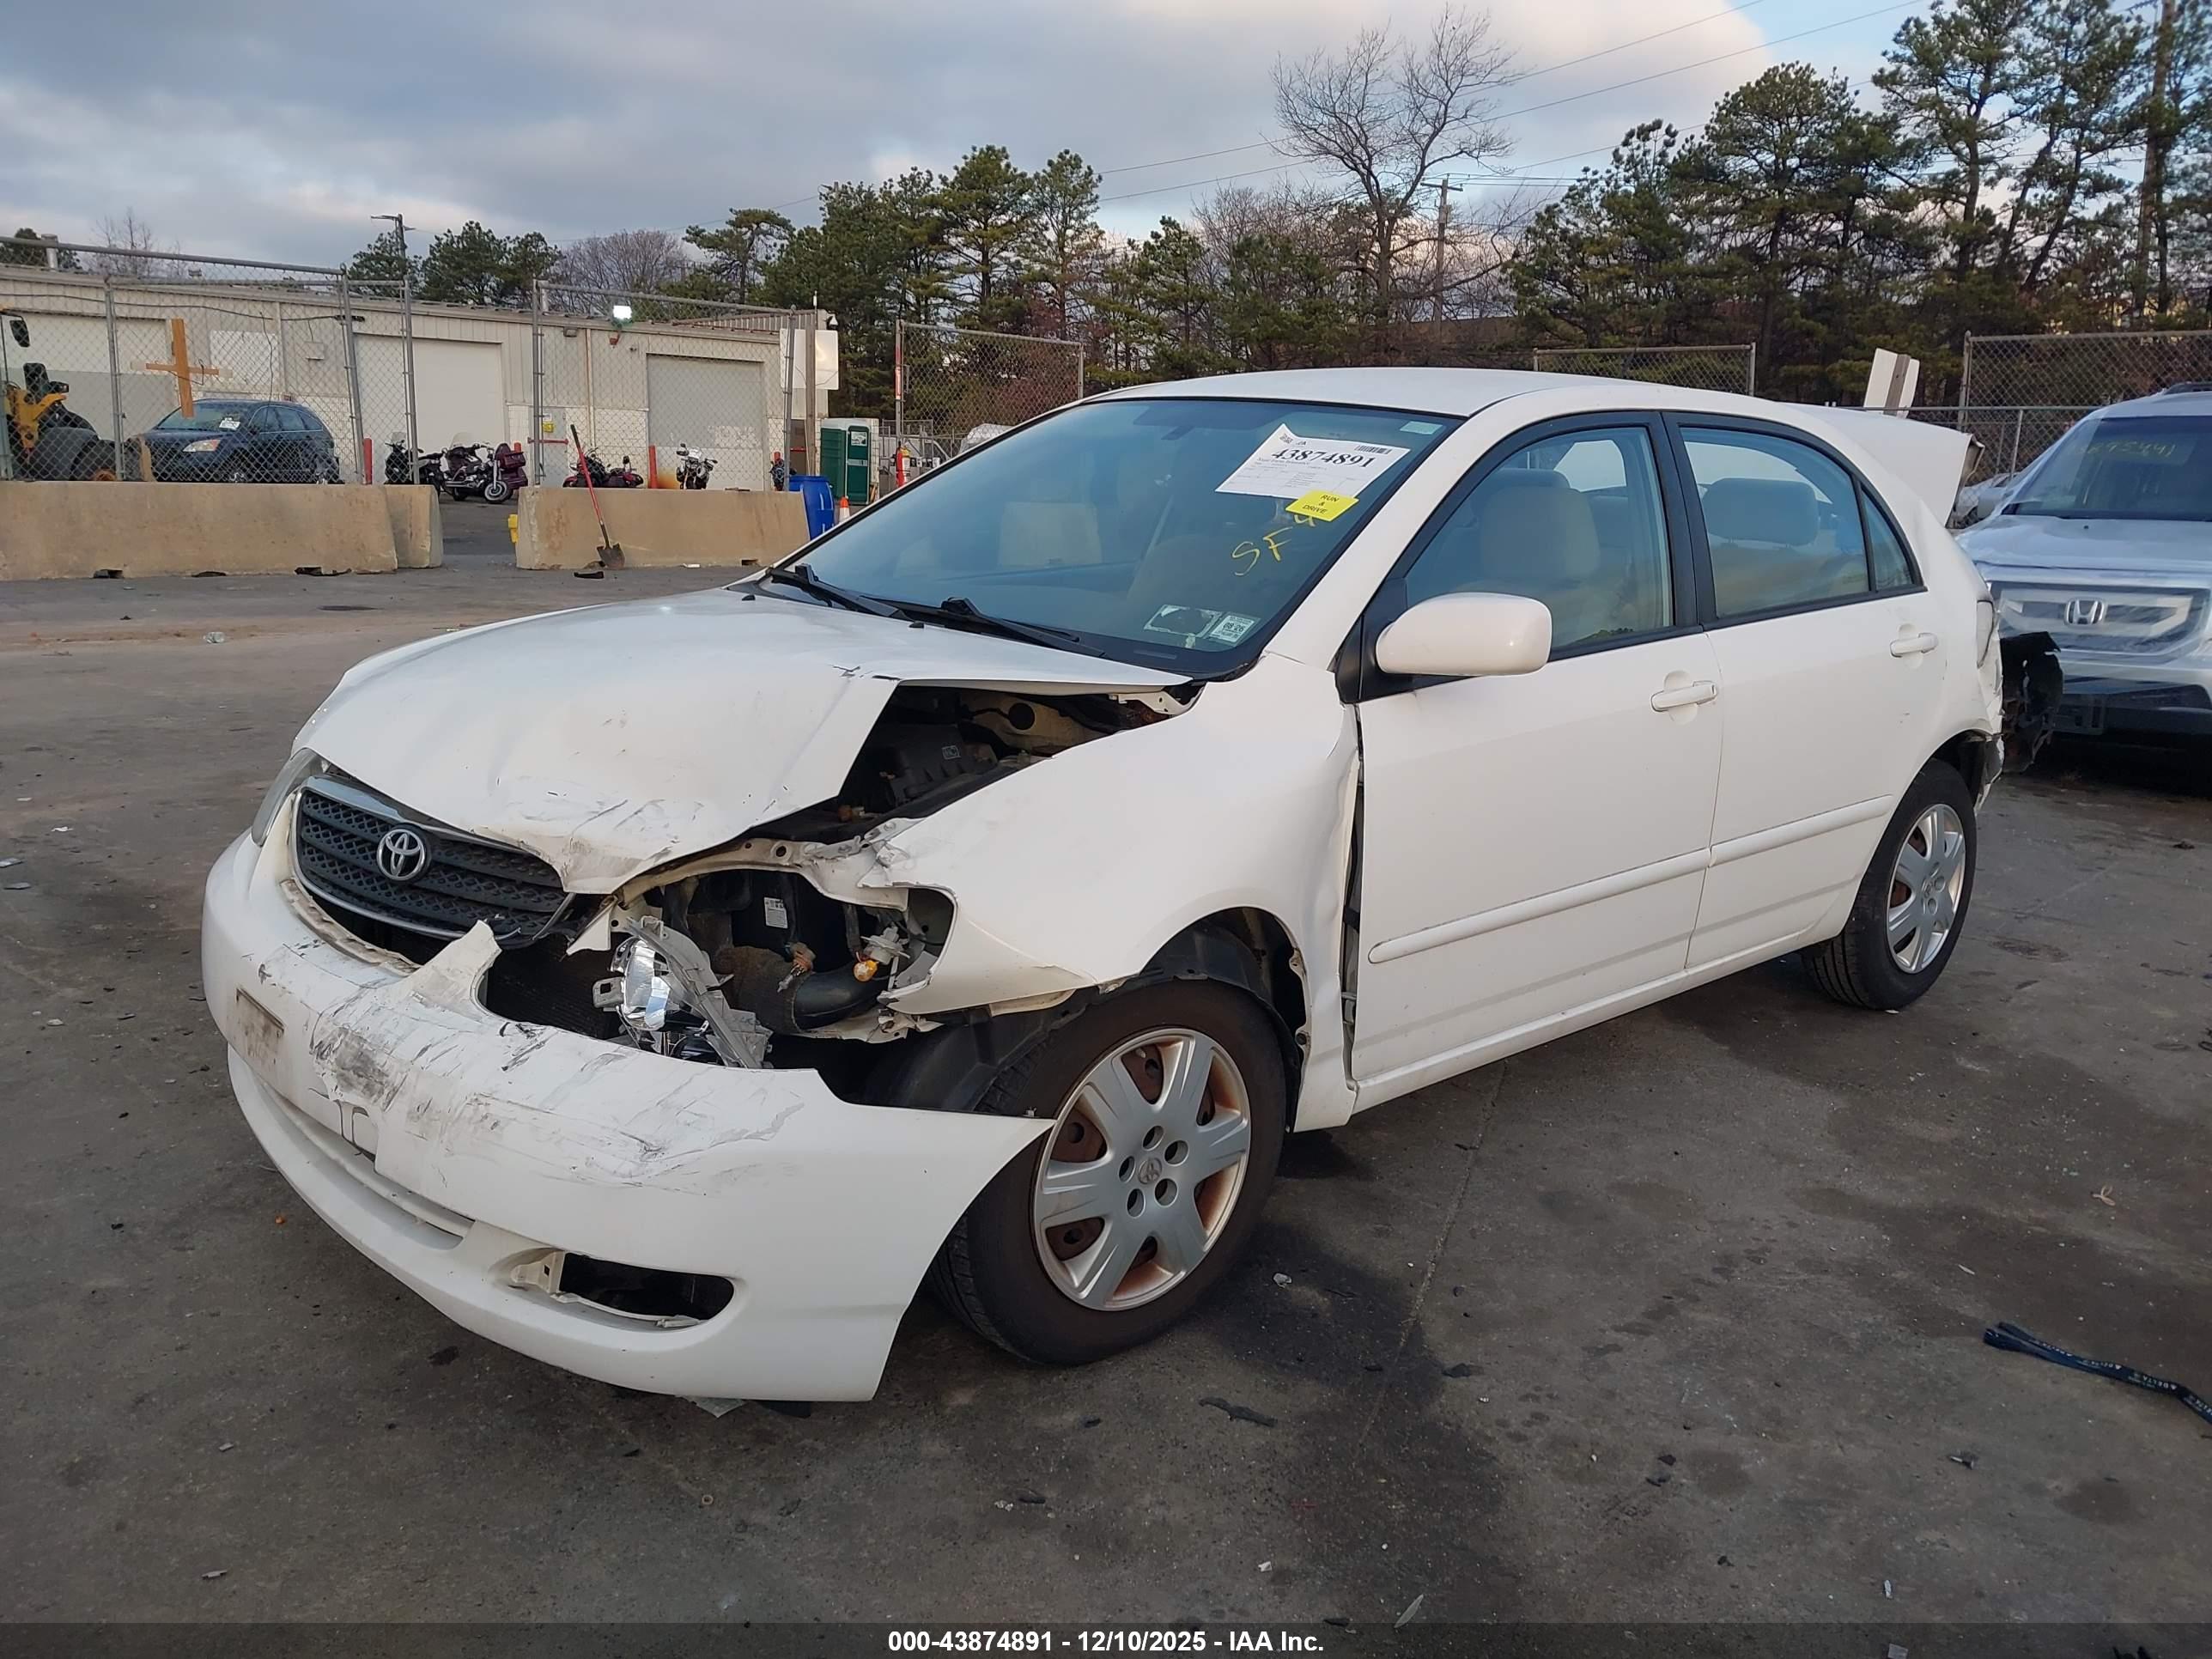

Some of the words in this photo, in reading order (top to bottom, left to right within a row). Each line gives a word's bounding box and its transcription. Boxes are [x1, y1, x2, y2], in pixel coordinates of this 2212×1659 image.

[1271, 447, 1376, 468] 43874891
[1320, 494, 1340, 502] RUN
[1302, 504, 1328, 514] DRIVE
